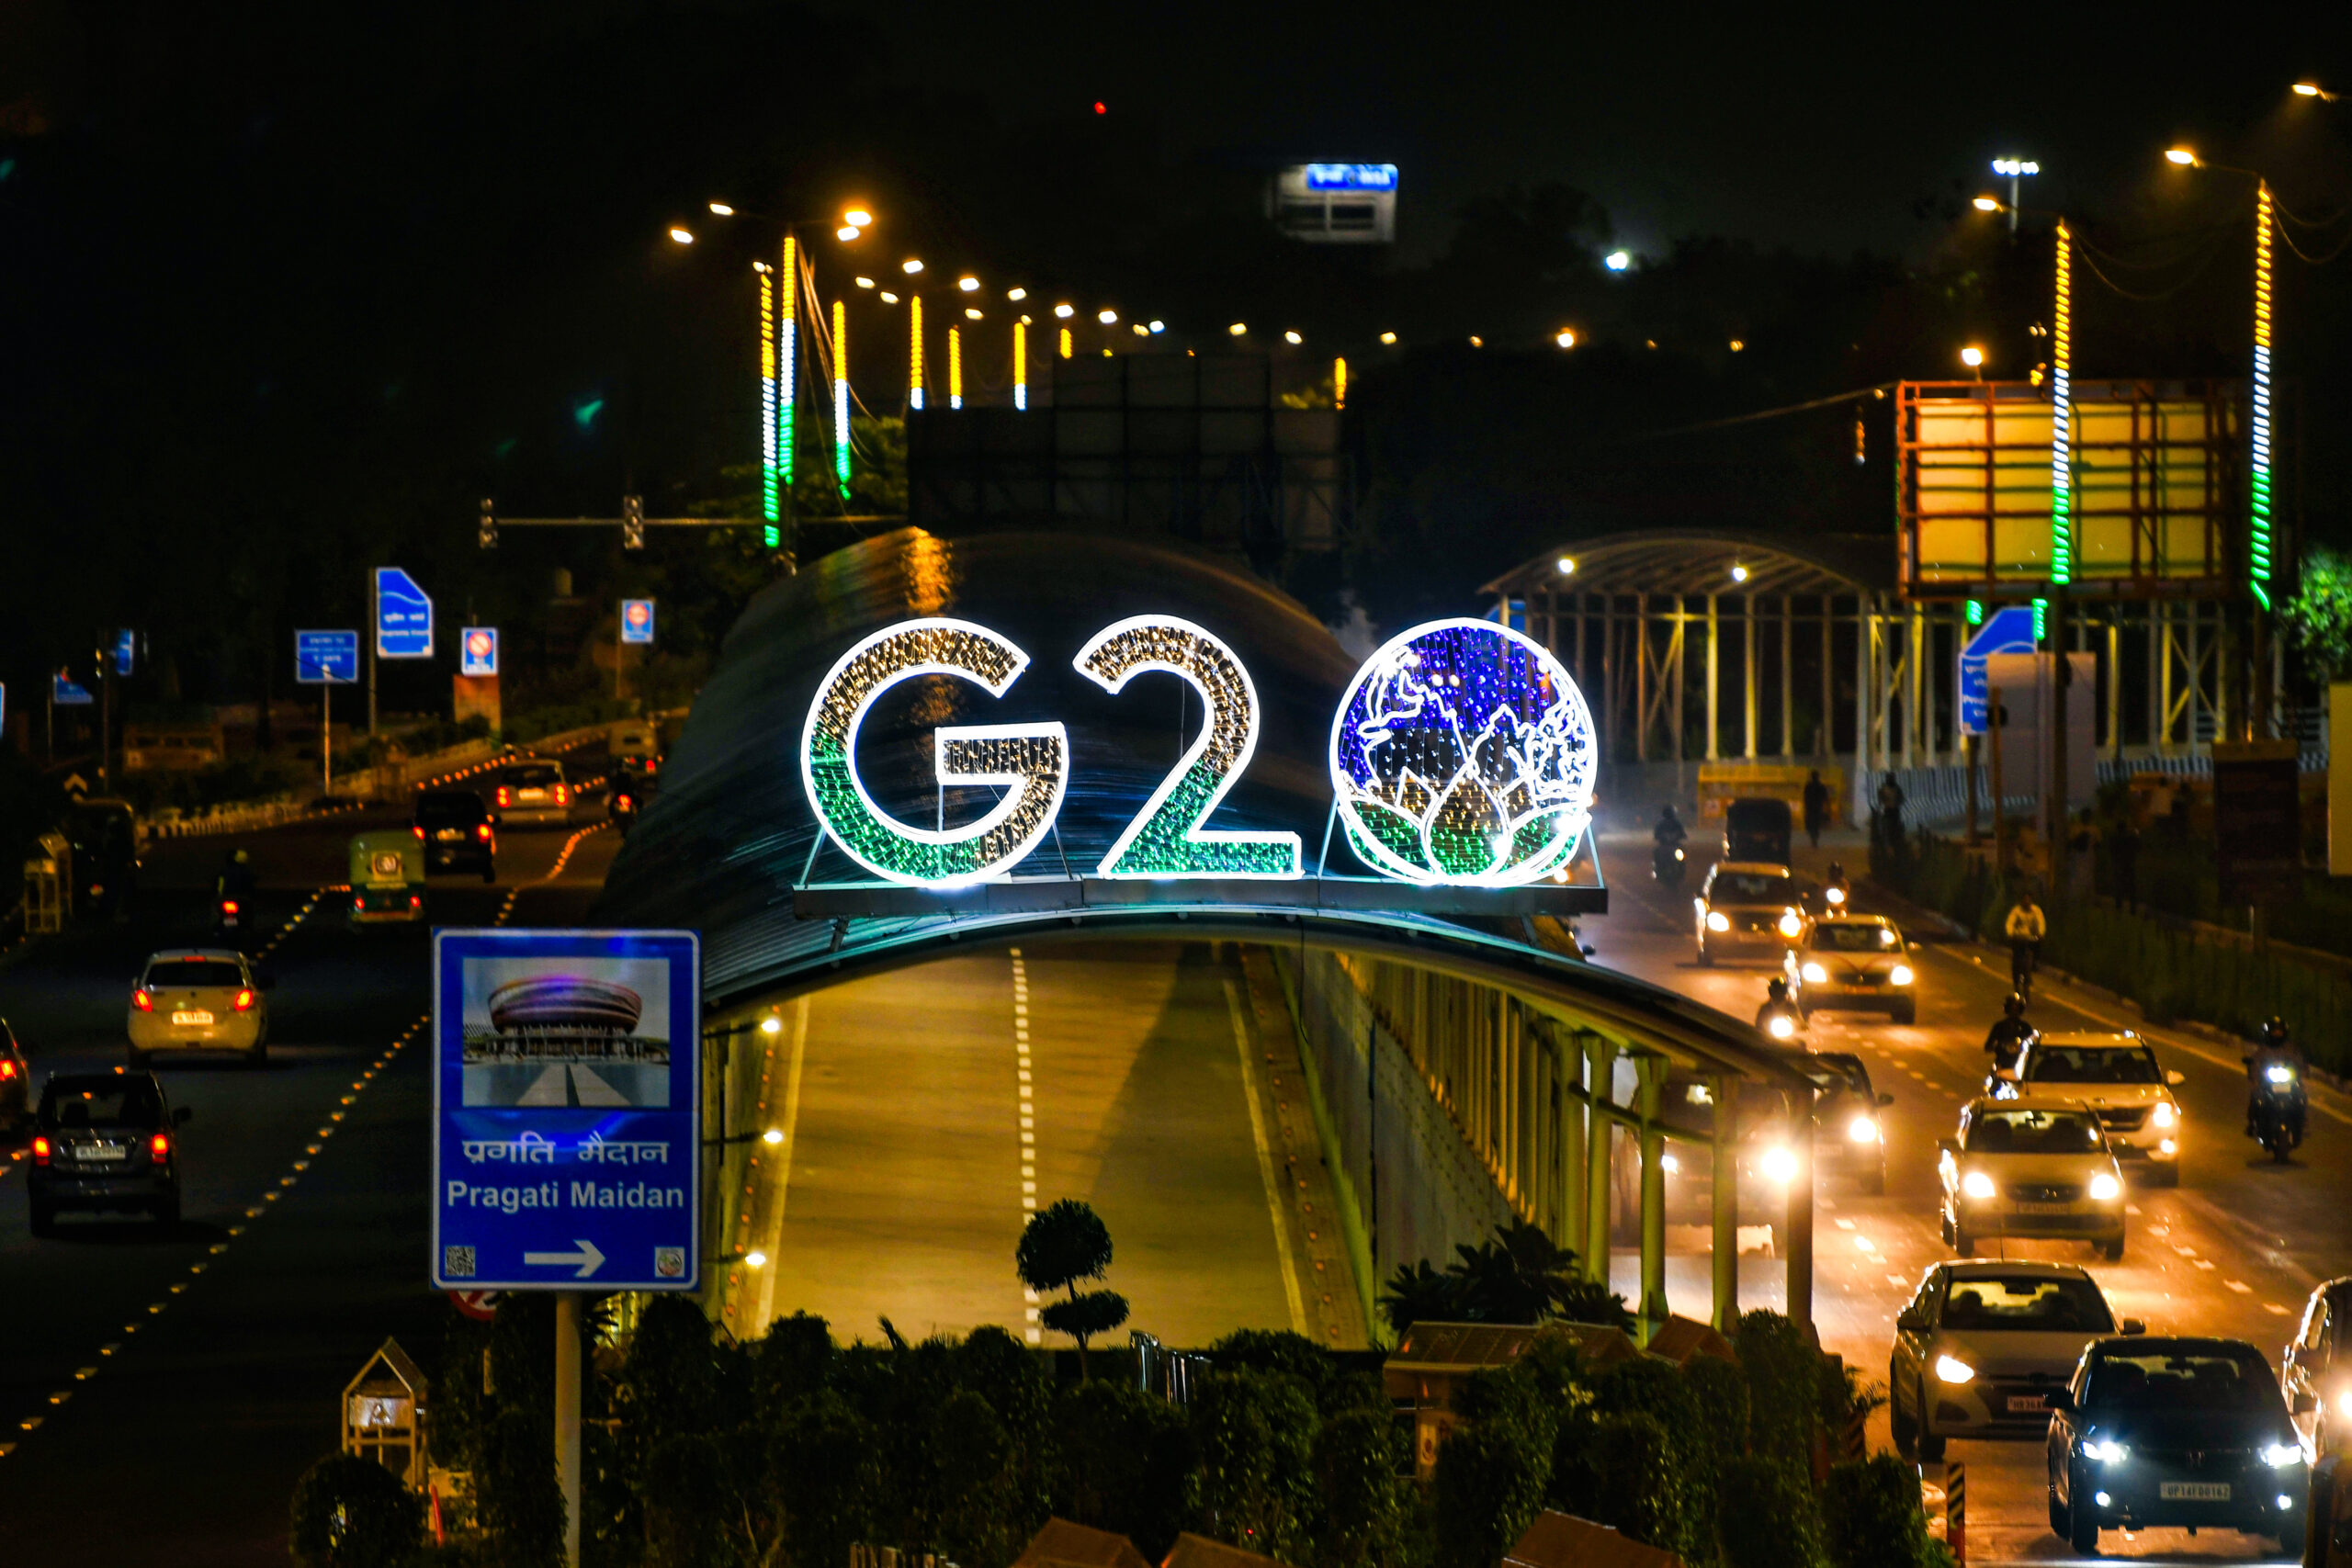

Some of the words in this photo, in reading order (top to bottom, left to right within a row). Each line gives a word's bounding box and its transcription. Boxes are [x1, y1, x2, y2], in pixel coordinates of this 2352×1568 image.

[462, 1130, 556, 1164] प्रगति
[577, 1130, 670, 1165] मैदान
[447, 1179, 559, 1214] Pragati
[571, 1180, 684, 1207] Maidan
